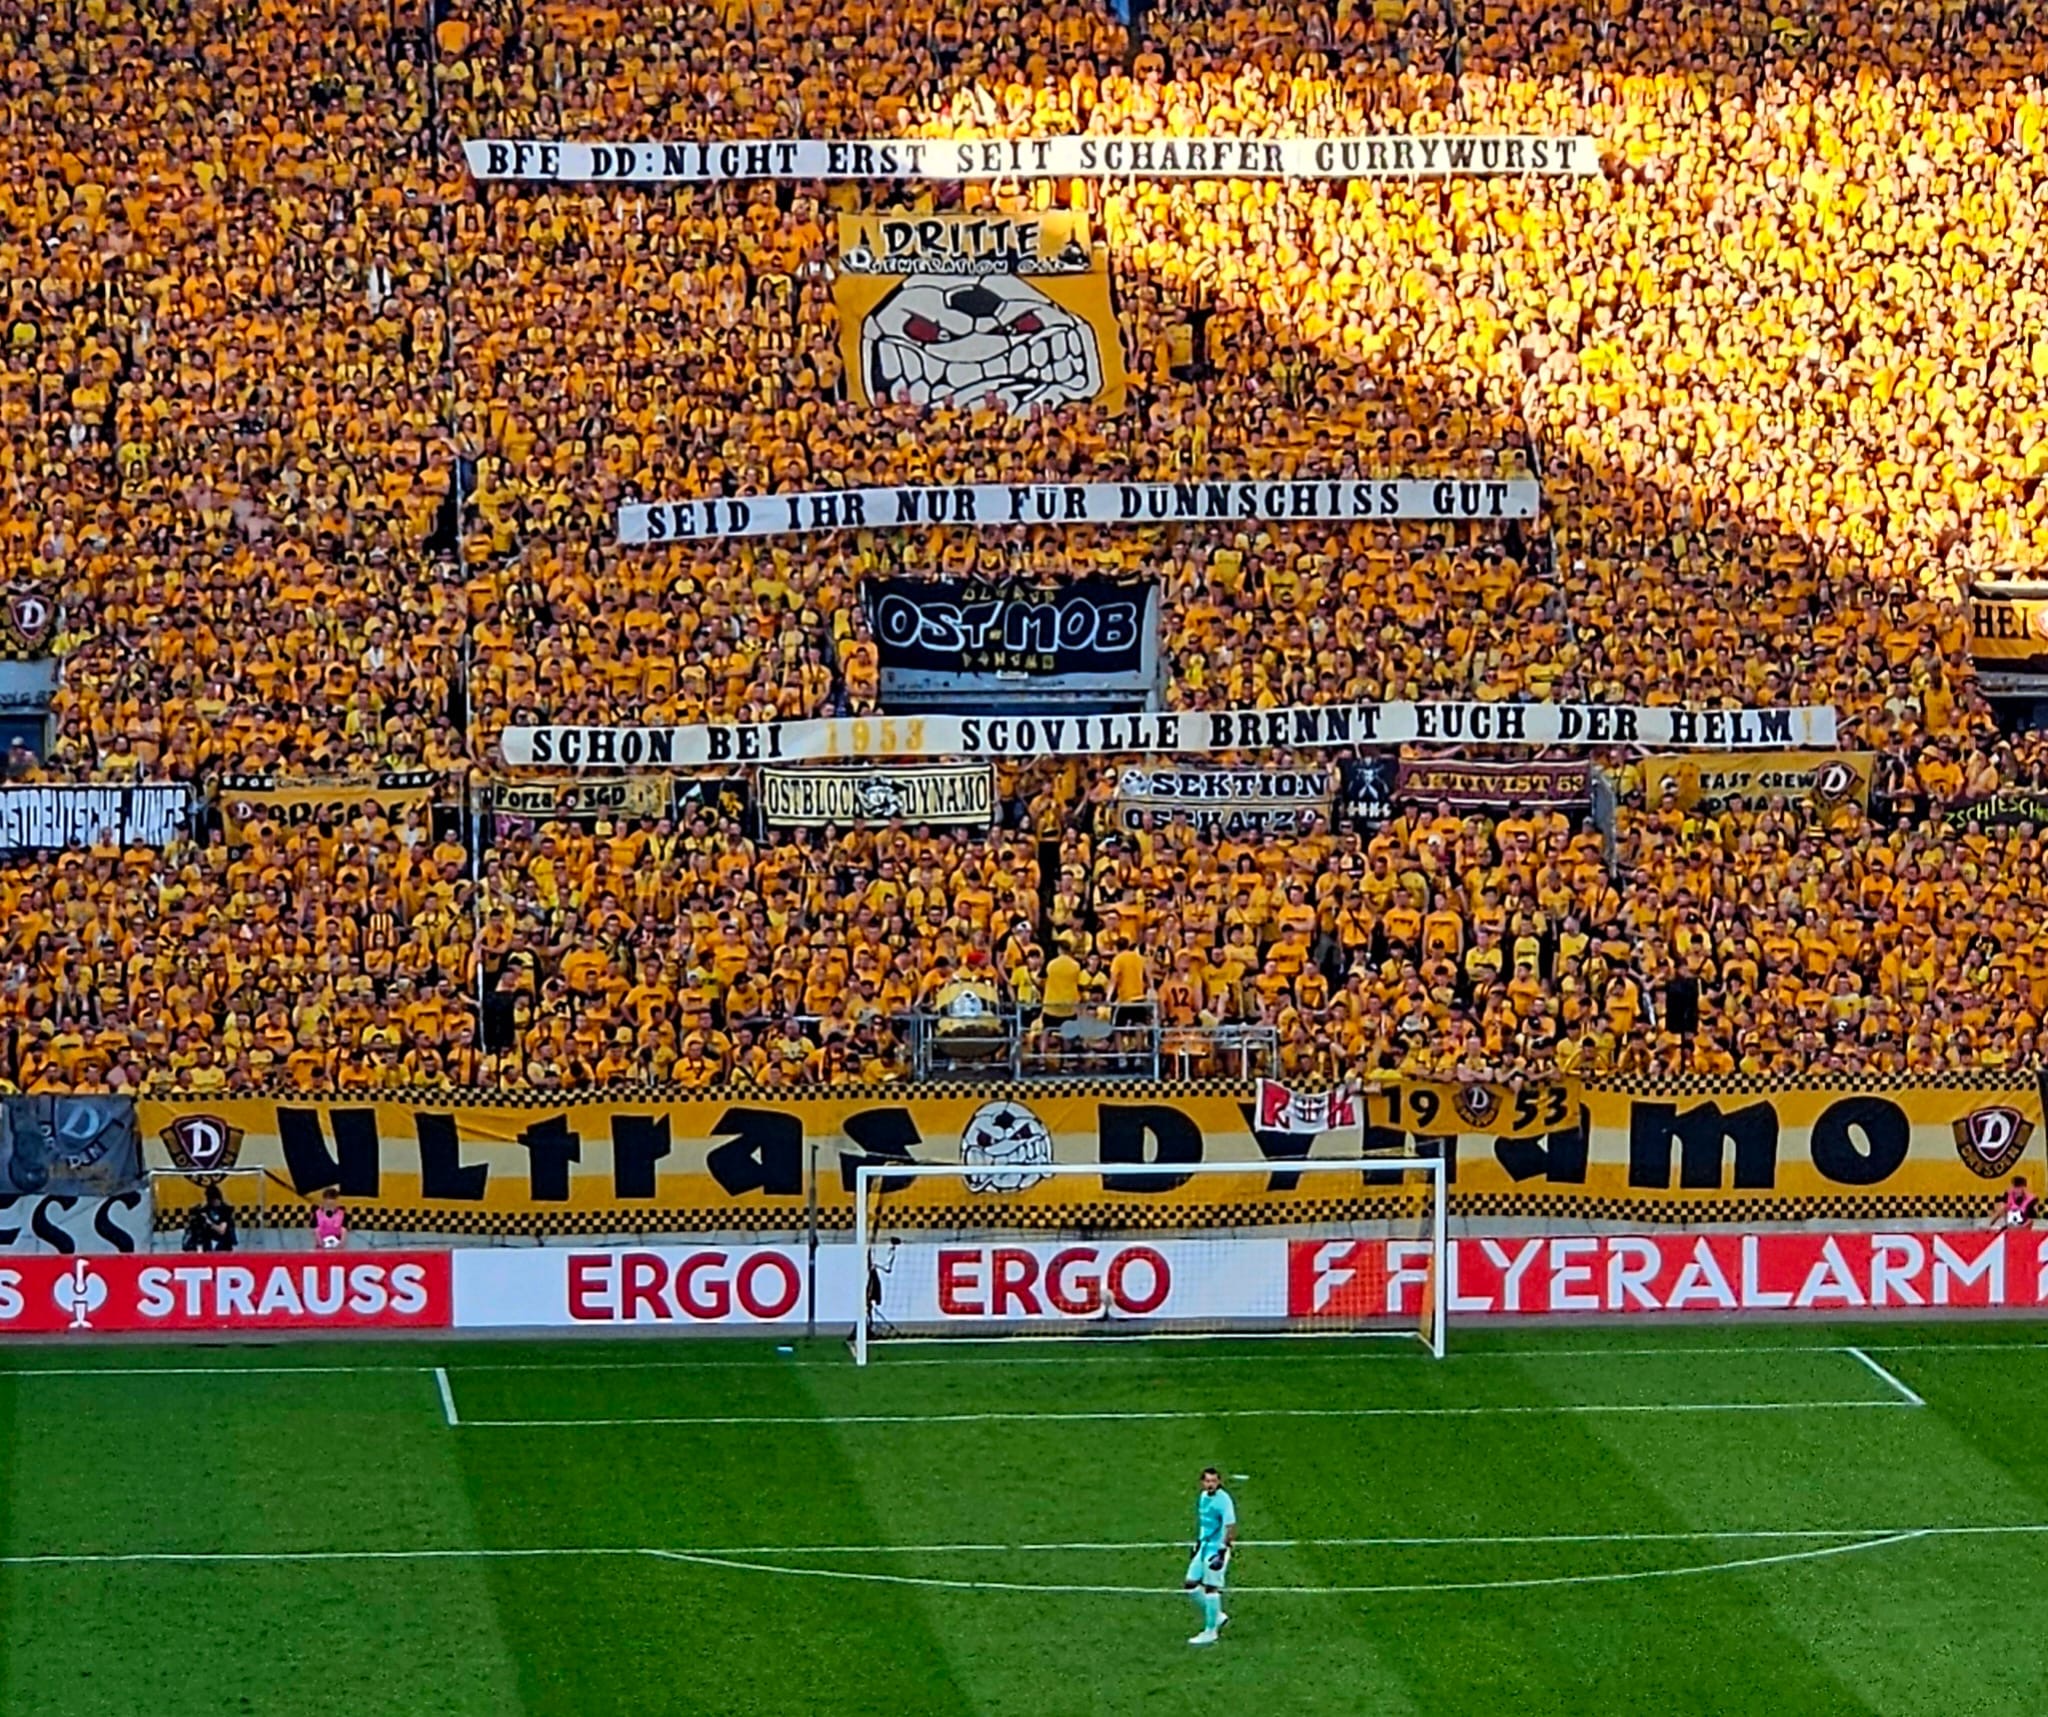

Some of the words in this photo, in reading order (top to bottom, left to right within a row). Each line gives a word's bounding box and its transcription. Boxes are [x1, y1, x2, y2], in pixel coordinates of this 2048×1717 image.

[488, 142, 560, 176] BFE
[828, 141, 927, 173] ERST
[956, 140, 1053, 173] SEIT
[1080, 139, 1284, 173] SCHARFER
[1315, 138, 1578, 171] CURRYWURST
[883, 219, 1040, 258] DRITTE
[647, 500, 750, 540] SEID
[786, 492, 867, 529] IHR
[897, 488, 977, 522] NUR
[1008, 486, 1088, 520] FÜR
[1120, 483, 1400, 518] DÜNNSCHISS
[1433, 483, 1528, 516] GUT.
[532, 728, 674, 764] SCHON
[706, 723, 783, 761] BEI
[825, 719, 925, 754] 1953
[962, 716, 1179, 752] SCOVILLE
[1209, 706, 1382, 748] BRENNT
[1414, 705, 1527, 739] EUCH
[1558, 708, 1639, 741] DER
[583, 786, 627, 808] SGD
[905, 775, 988, 814] DYNAMO
[1152, 772, 1329, 798] SEKTION
[1403, 771, 1551, 794] AKTIVIST
[1556, 774, 1586, 793] 53
[1699, 772, 1752, 790] EAST
[1758, 771, 1818, 789] CREW
[1170, 987, 1189, 1008] 12
[1382, 1084, 1440, 1129] 19
[1513, 1085, 1568, 1132] 53
[181, 1120, 221, 1158] D
[1977, 1111, 2011, 1149] D
[137, 1263, 428, 1318] STRAUSS
[568, 1250, 802, 1321] ERGO
[938, 1246, 1171, 1317] ERGO
[1386, 1234, 2006, 1313] FLYERALARM
